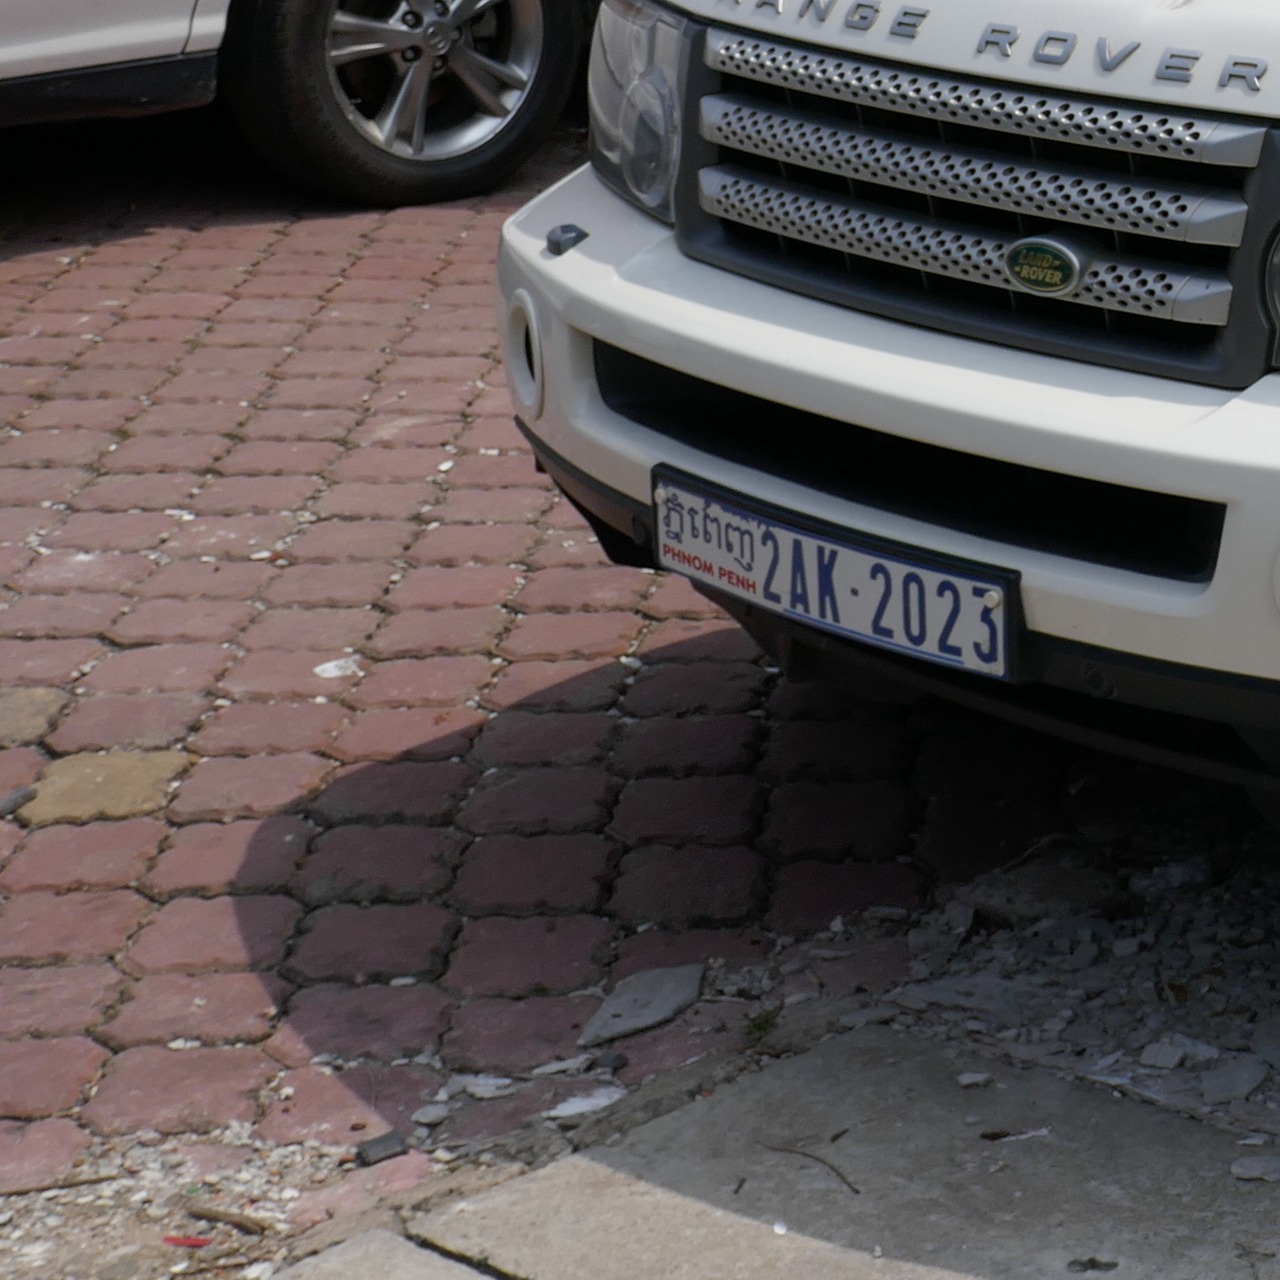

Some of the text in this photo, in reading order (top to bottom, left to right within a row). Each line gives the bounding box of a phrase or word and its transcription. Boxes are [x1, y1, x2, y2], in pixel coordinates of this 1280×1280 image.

[976, 23, 1269, 92] ROVER
[1020, 264, 1063, 286] ROVER
[663, 543, 757, 595] PHNOM PENH
